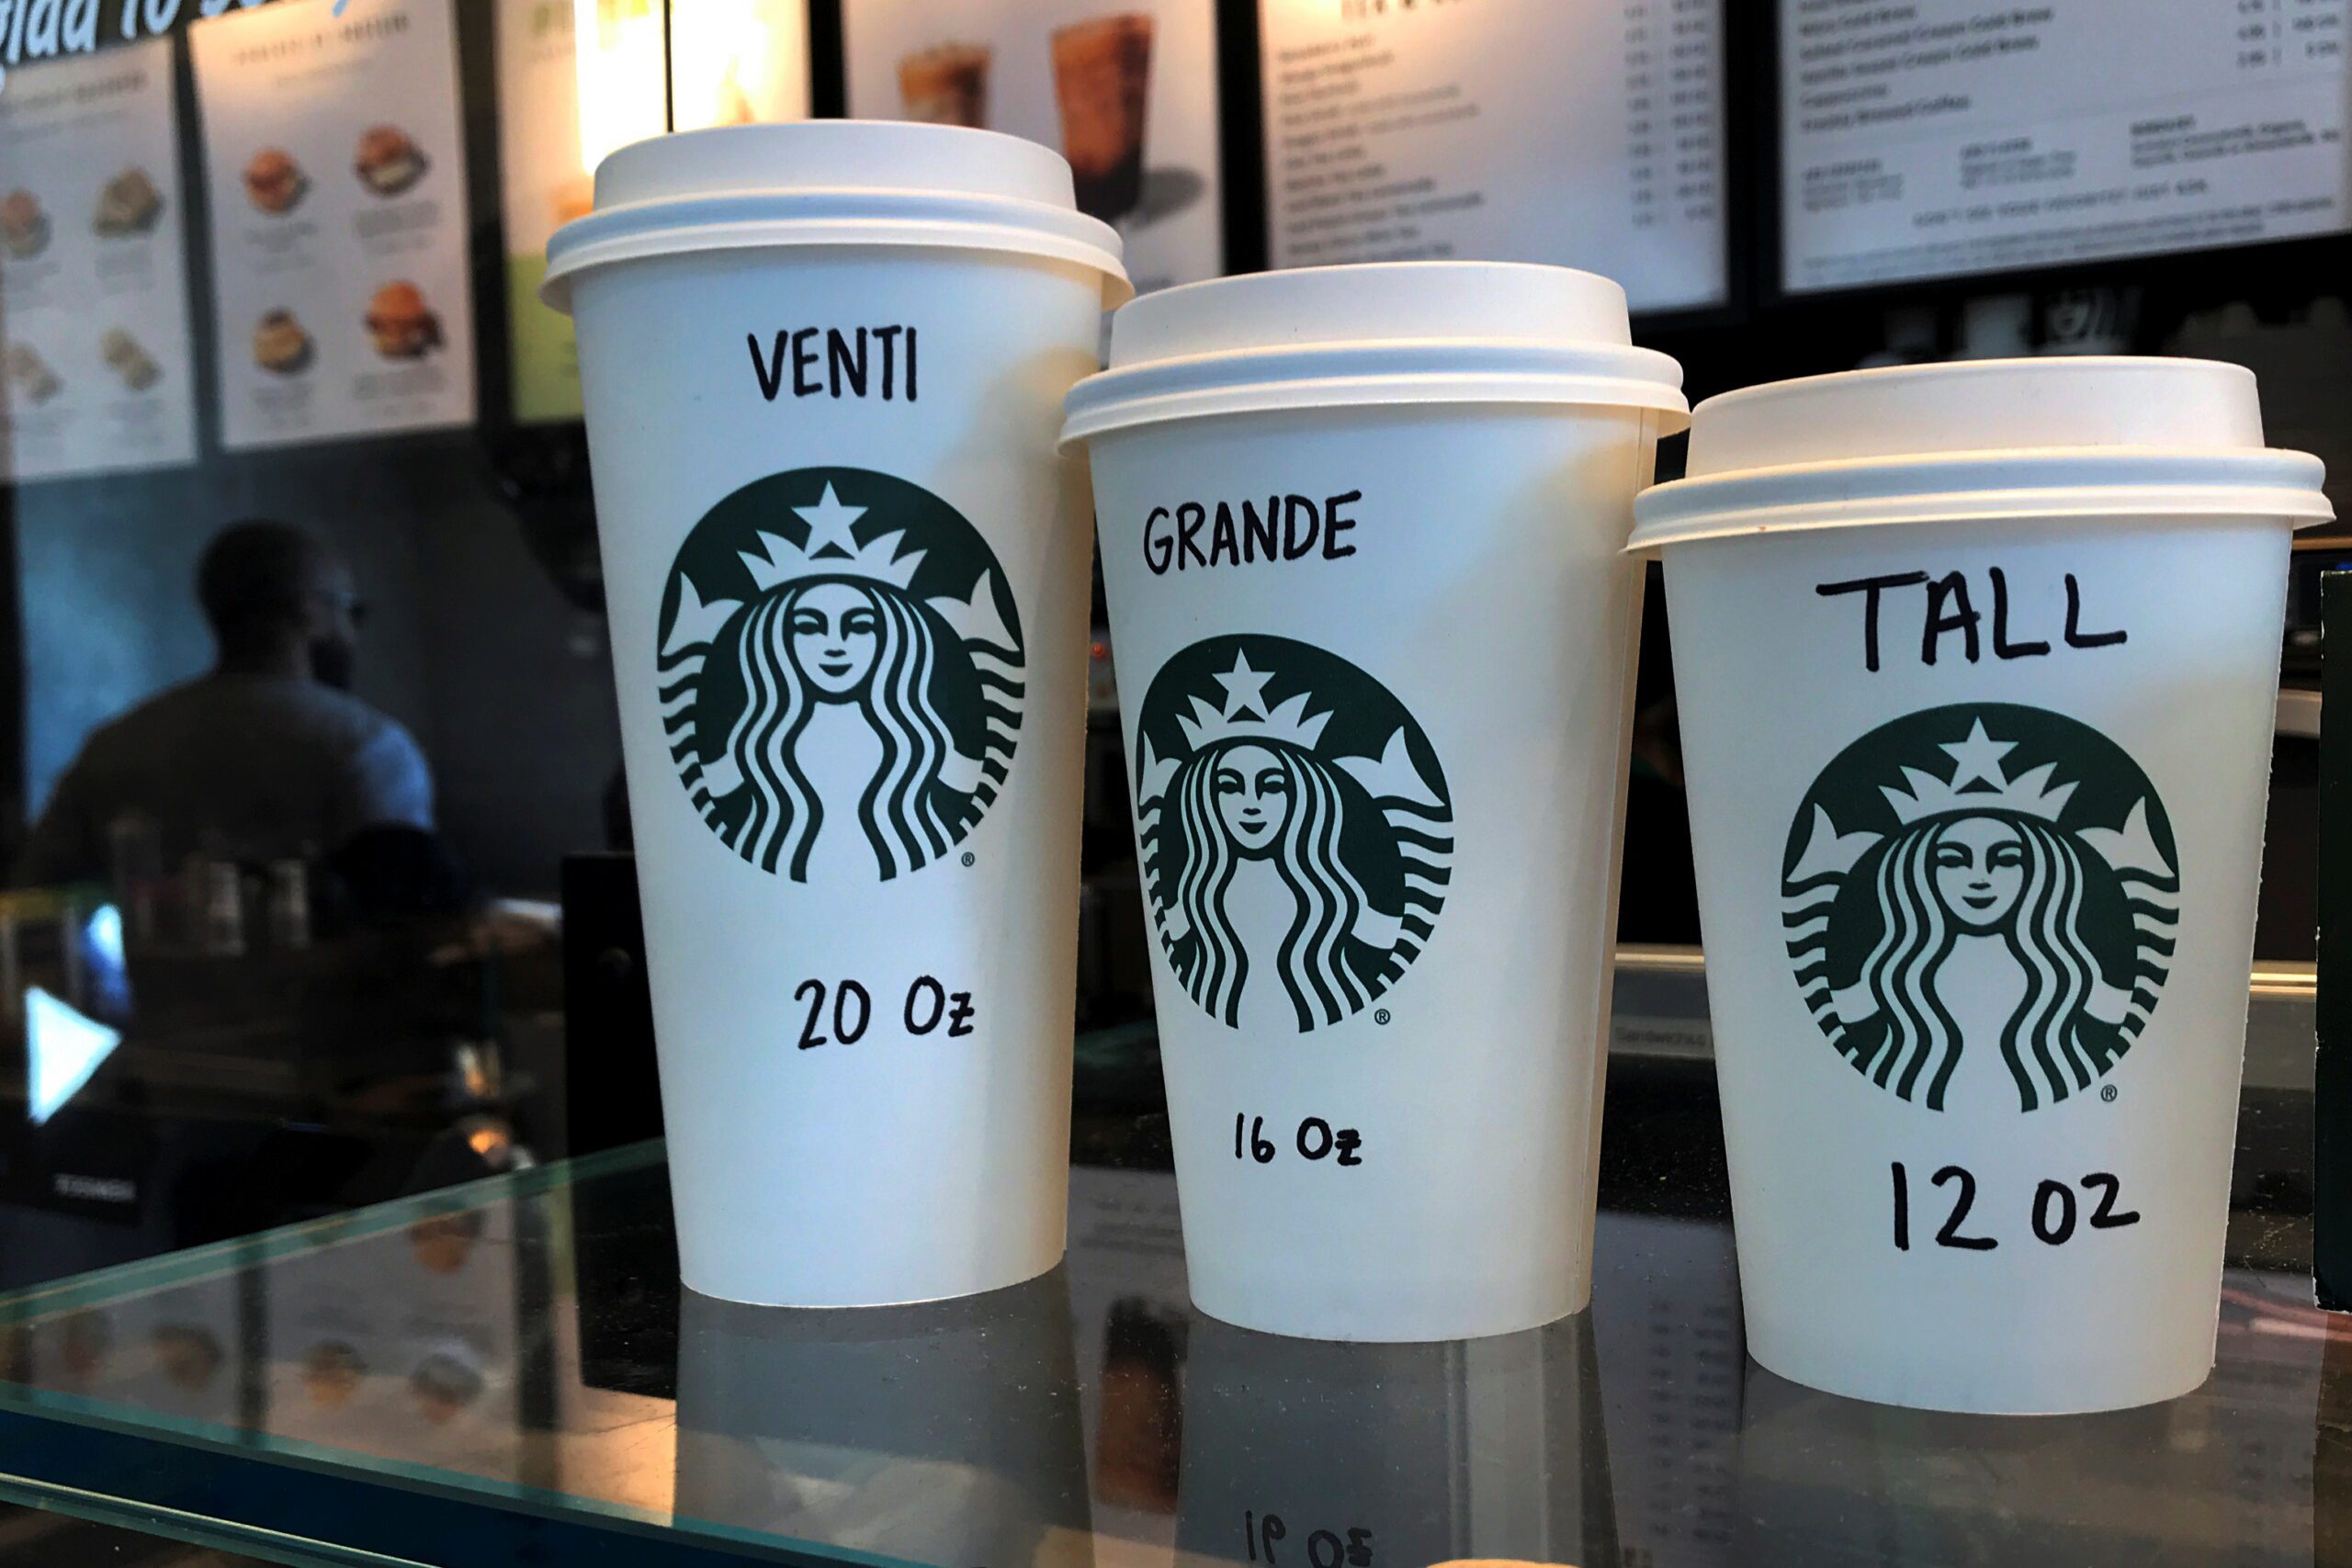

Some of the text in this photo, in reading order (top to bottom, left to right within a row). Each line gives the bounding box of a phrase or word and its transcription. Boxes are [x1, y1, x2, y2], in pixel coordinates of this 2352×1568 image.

[747, 324, 917, 402] VENTI
[1144, 490, 1362, 575] GRANDE
[1815, 567, 2128, 672] TALL
[795, 978, 871, 1050] 20
[1235, 1112, 1275, 1164] 16
[1891, 1161, 1998, 1251] 12
